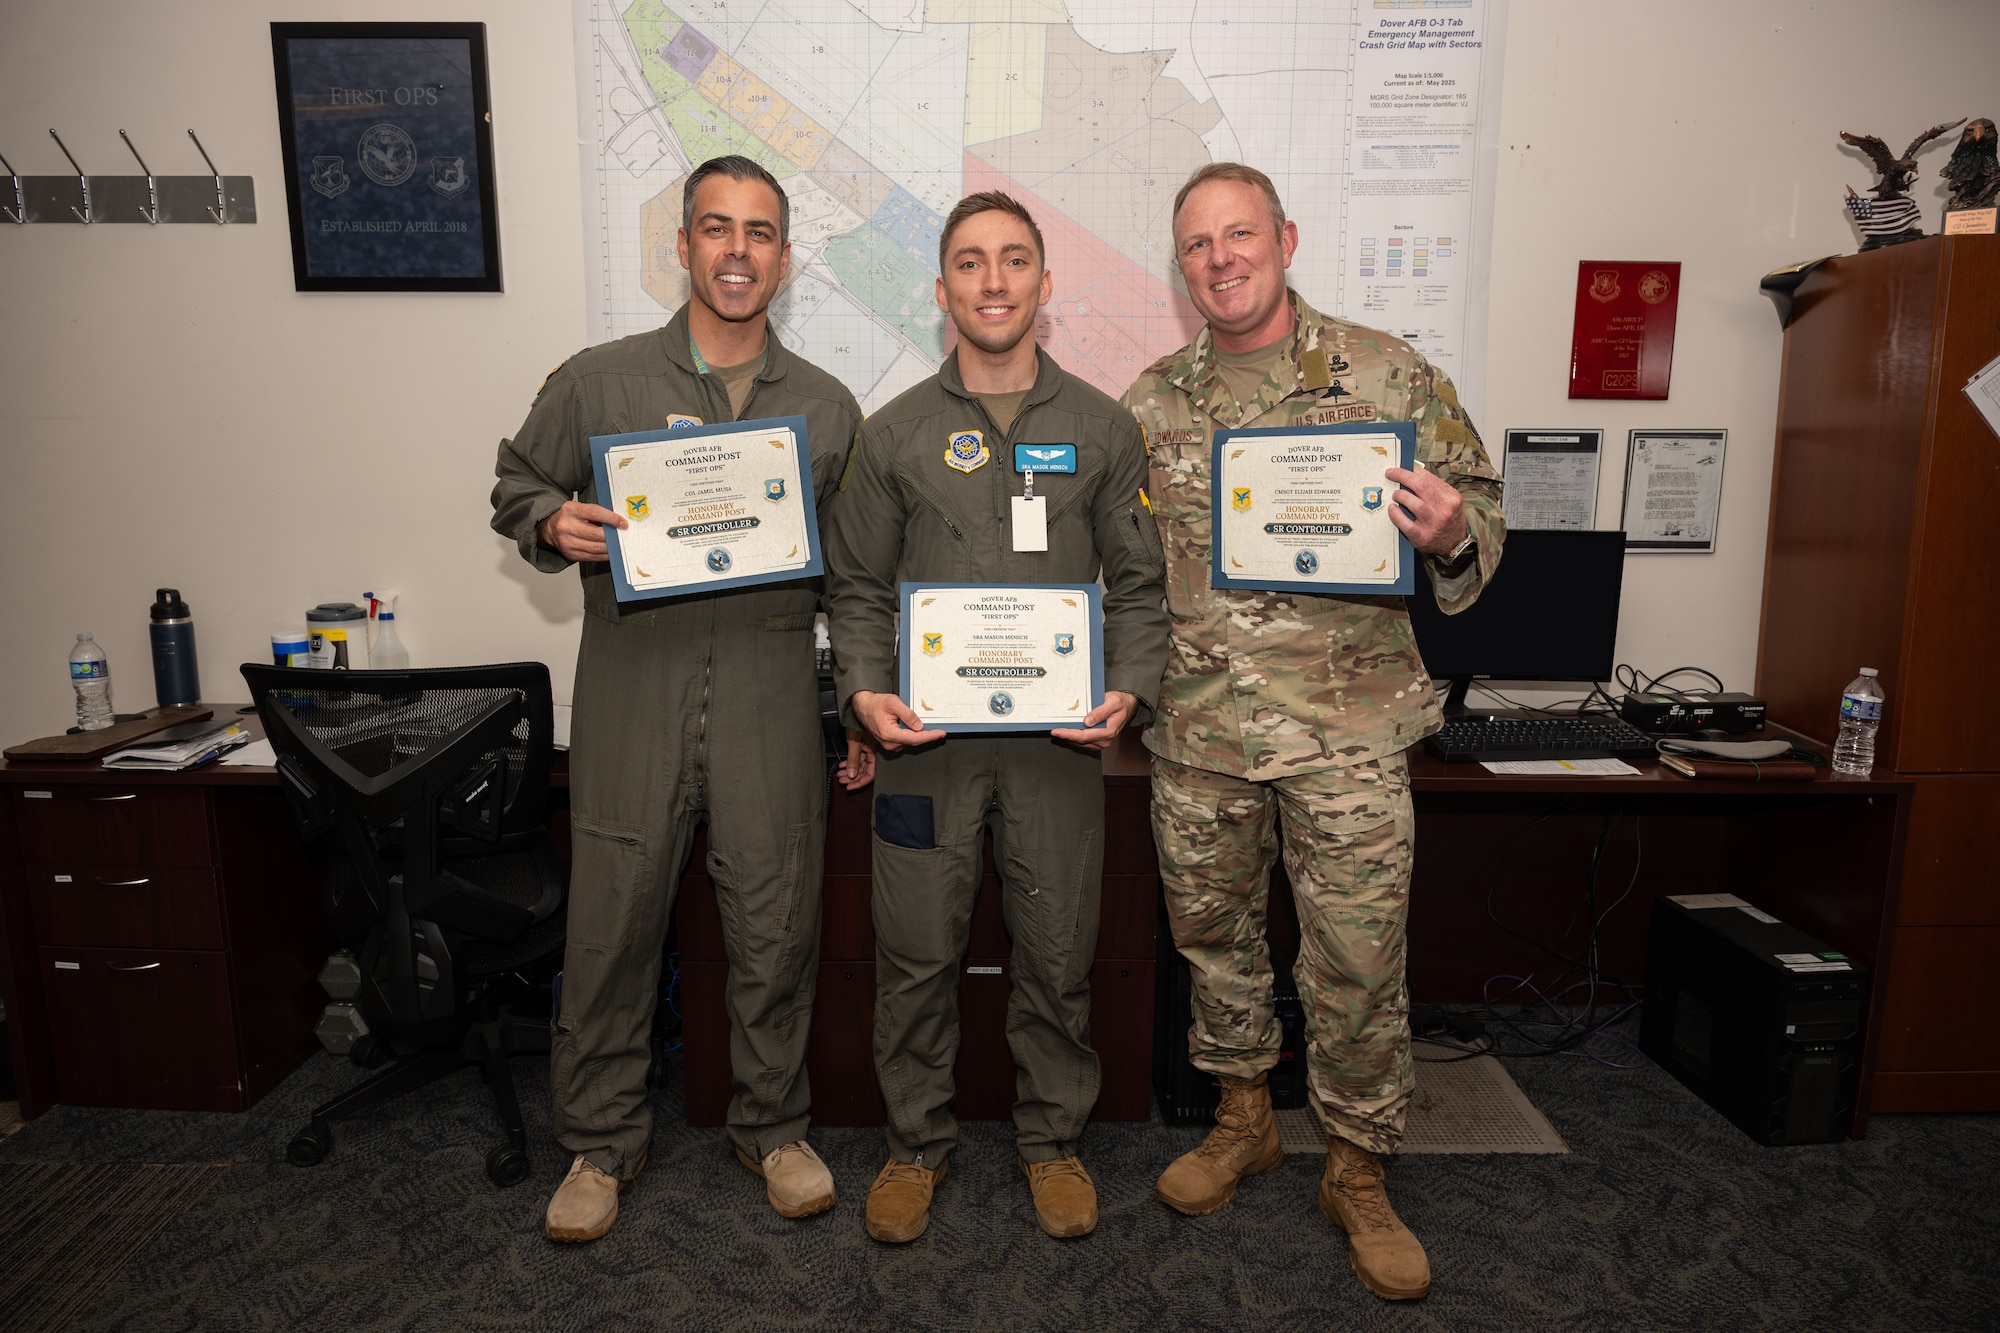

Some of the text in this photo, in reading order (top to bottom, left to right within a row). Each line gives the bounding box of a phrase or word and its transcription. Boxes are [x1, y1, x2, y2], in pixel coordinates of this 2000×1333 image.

[1380, 19, 1406, 27] Dover
[1368, 30, 1474, 40] Emergency Management
[1408, 41, 1426, 50] Map
[1006, 73, 1018, 81] 2-C
[330, 86, 438, 105] FIRST OPS
[751, 95, 768, 103] 10-B
[700, 125, 716, 133] 11-B
[795, 131, 811, 139] 10-C
[321, 220, 467, 232] ESTABLISHED APRIL 2018
[1606, 375, 1638, 386] C2OPS
[1296, 406, 1371, 426] U.S. AIR FORCE
[684, 447, 707, 456] DOVER
[665, 452, 741, 467] COMMAND POST
[1271, 455, 1317, 463] COMMAND
[688, 502, 735, 514] HONORARY
[678, 508, 746, 523] COMMAND POST
[677, 519, 752, 536] SR CONTROLLER
[1286, 525, 1344, 534] CONTROLLER
